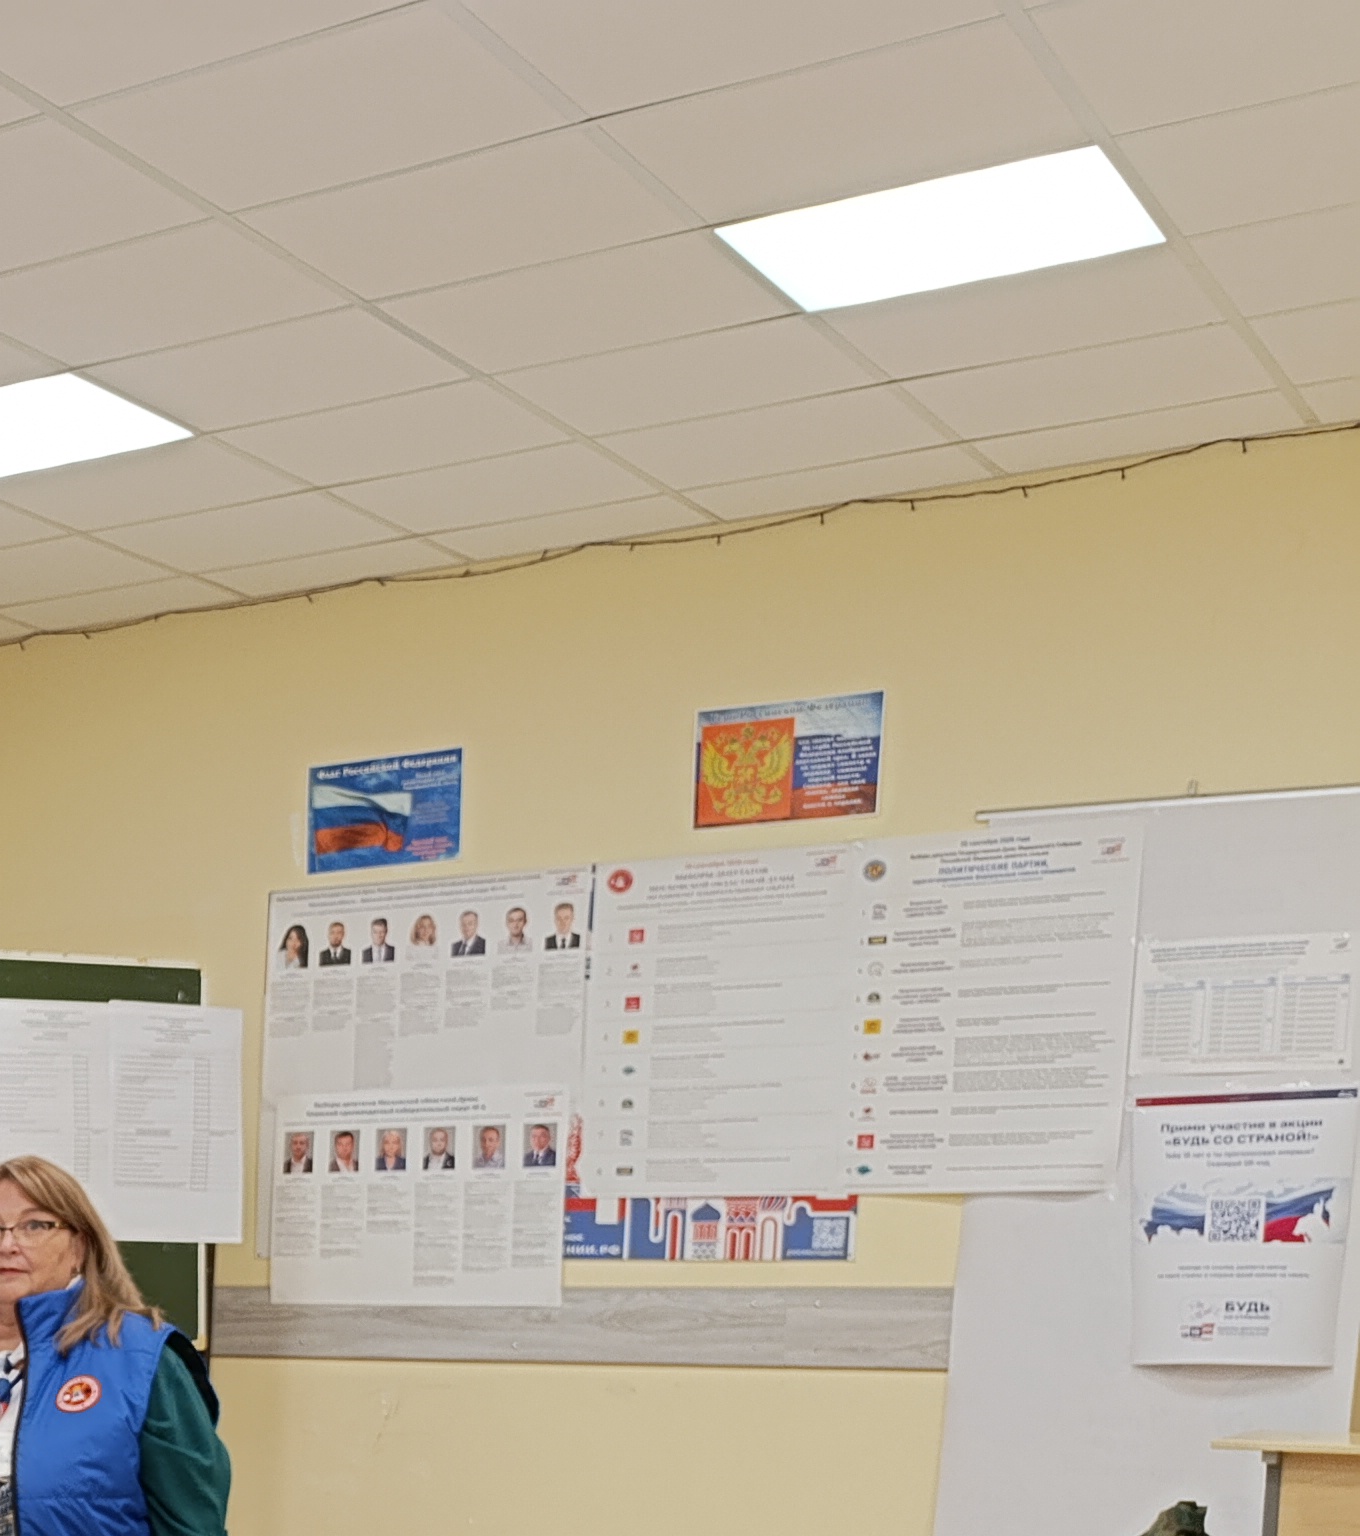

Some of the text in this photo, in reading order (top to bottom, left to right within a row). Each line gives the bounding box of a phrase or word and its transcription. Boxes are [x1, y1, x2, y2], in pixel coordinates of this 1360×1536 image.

[1160, 1123, 1206, 1134] Прими
[1210, 1121, 1265, 1133] участие
[1280, 1119, 1323, 1129] акции
[1213, 1134, 1234, 1145] СО
[1225, 1300, 1271, 1314] БУДЬ
